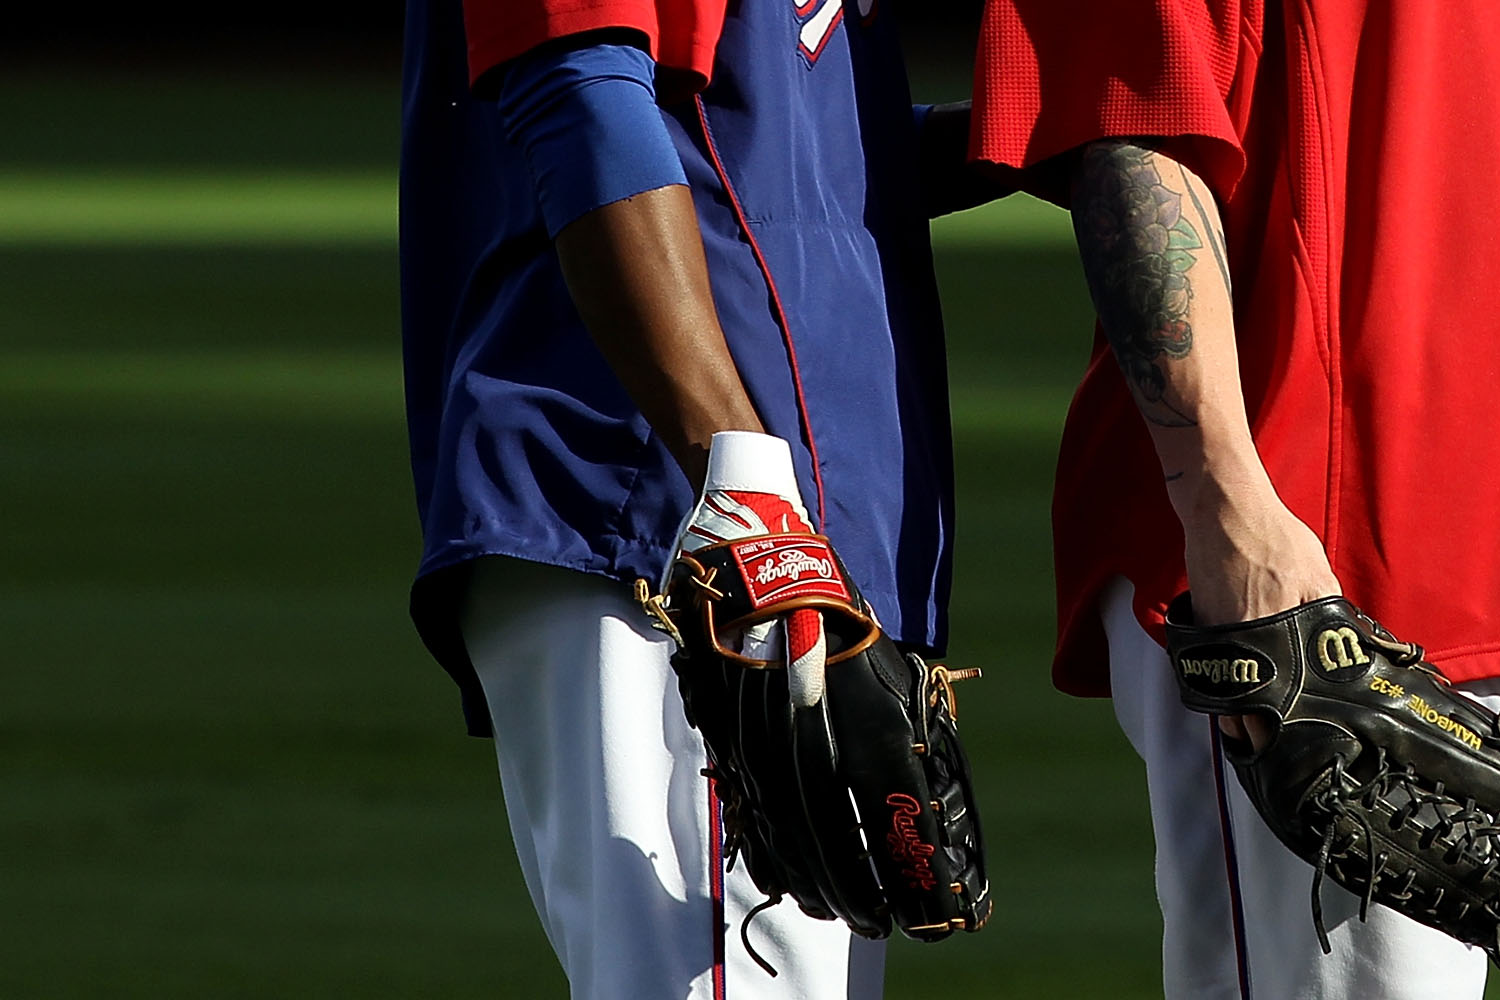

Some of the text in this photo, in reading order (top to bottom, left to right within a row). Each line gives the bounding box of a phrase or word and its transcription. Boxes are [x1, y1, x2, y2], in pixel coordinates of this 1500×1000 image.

[756, 558, 832, 585] Rawlings
[1180, 657, 1261, 684] Wilson
[1317, 626, 1371, 672] W
[1368, 674, 1483, 751] HAMBONE #32
[886, 793, 937, 890] Rawlings
